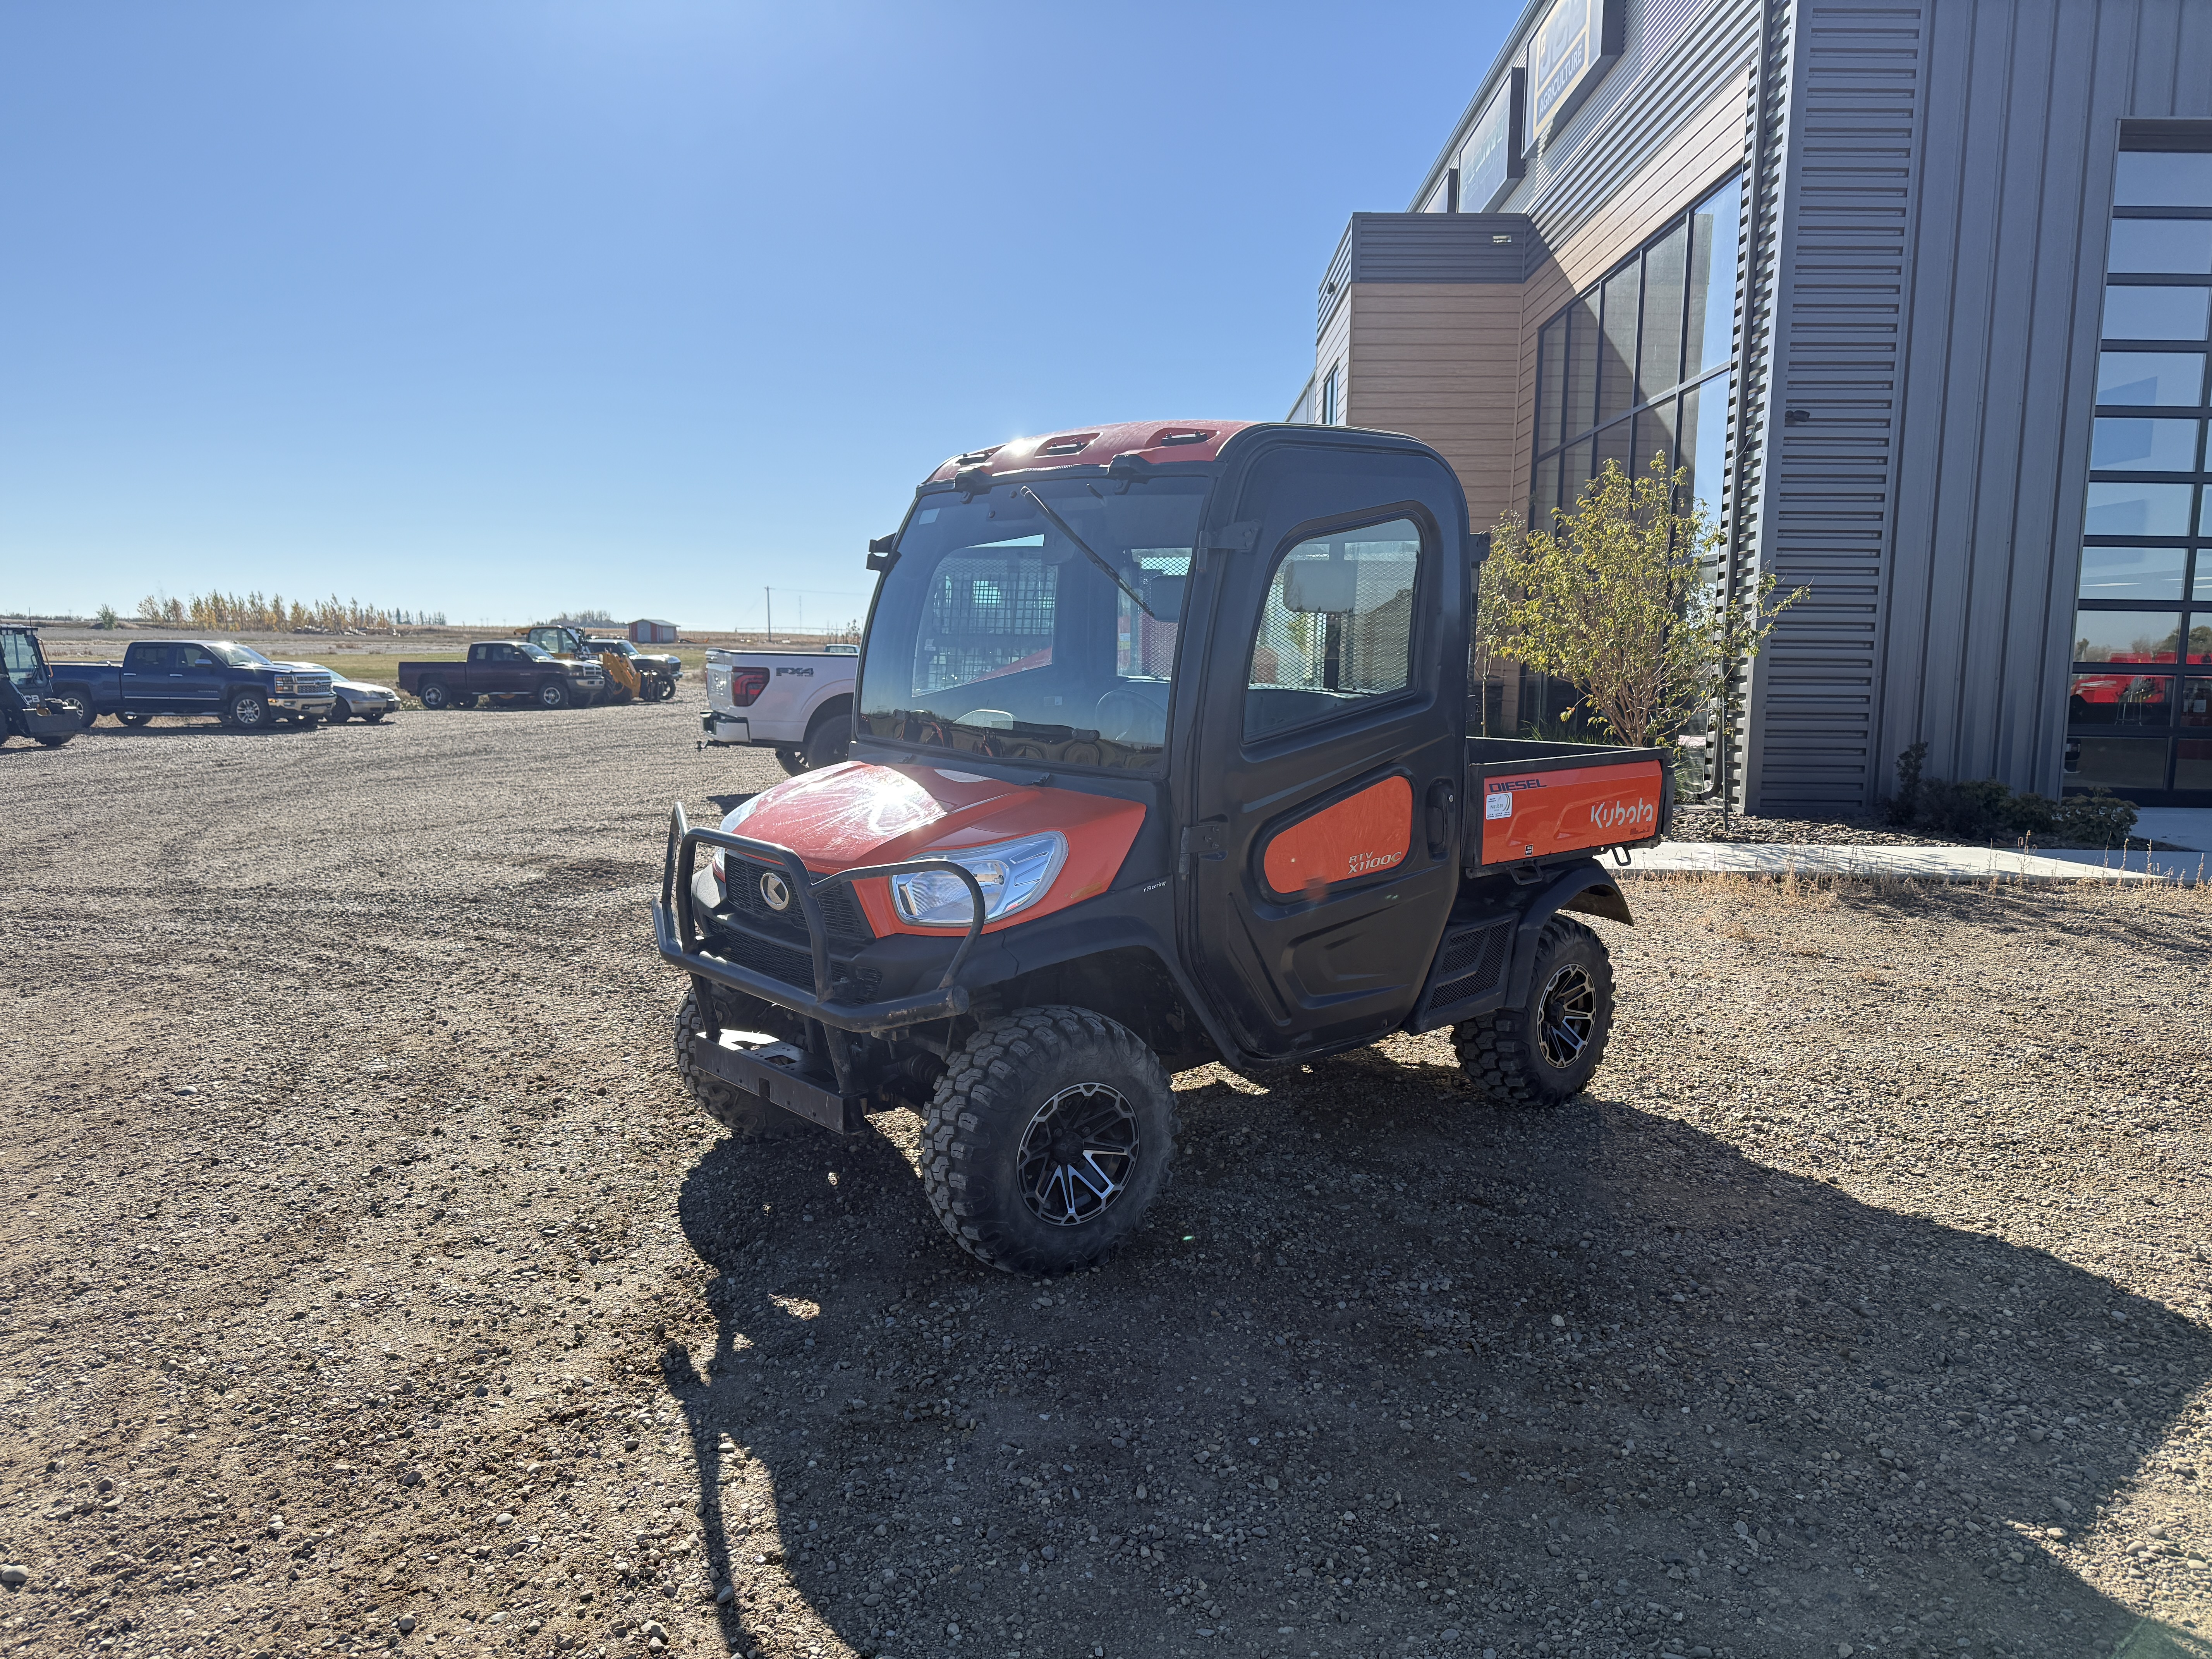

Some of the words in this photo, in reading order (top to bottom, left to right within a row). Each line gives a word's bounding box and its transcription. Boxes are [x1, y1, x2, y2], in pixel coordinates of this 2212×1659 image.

[1538, 43, 1583, 118] AGRICULTURE
[776, 667, 814, 676] FX4
[24, 695, 40, 703] CB
[1489, 779, 1547, 792] DIESEL
[1590, 797, 1653, 828] Kubota
[1348, 852, 1401, 874] X1100C
[1349, 851, 1373, 864] RTV
[1147, 881, 1166, 891] Steering
